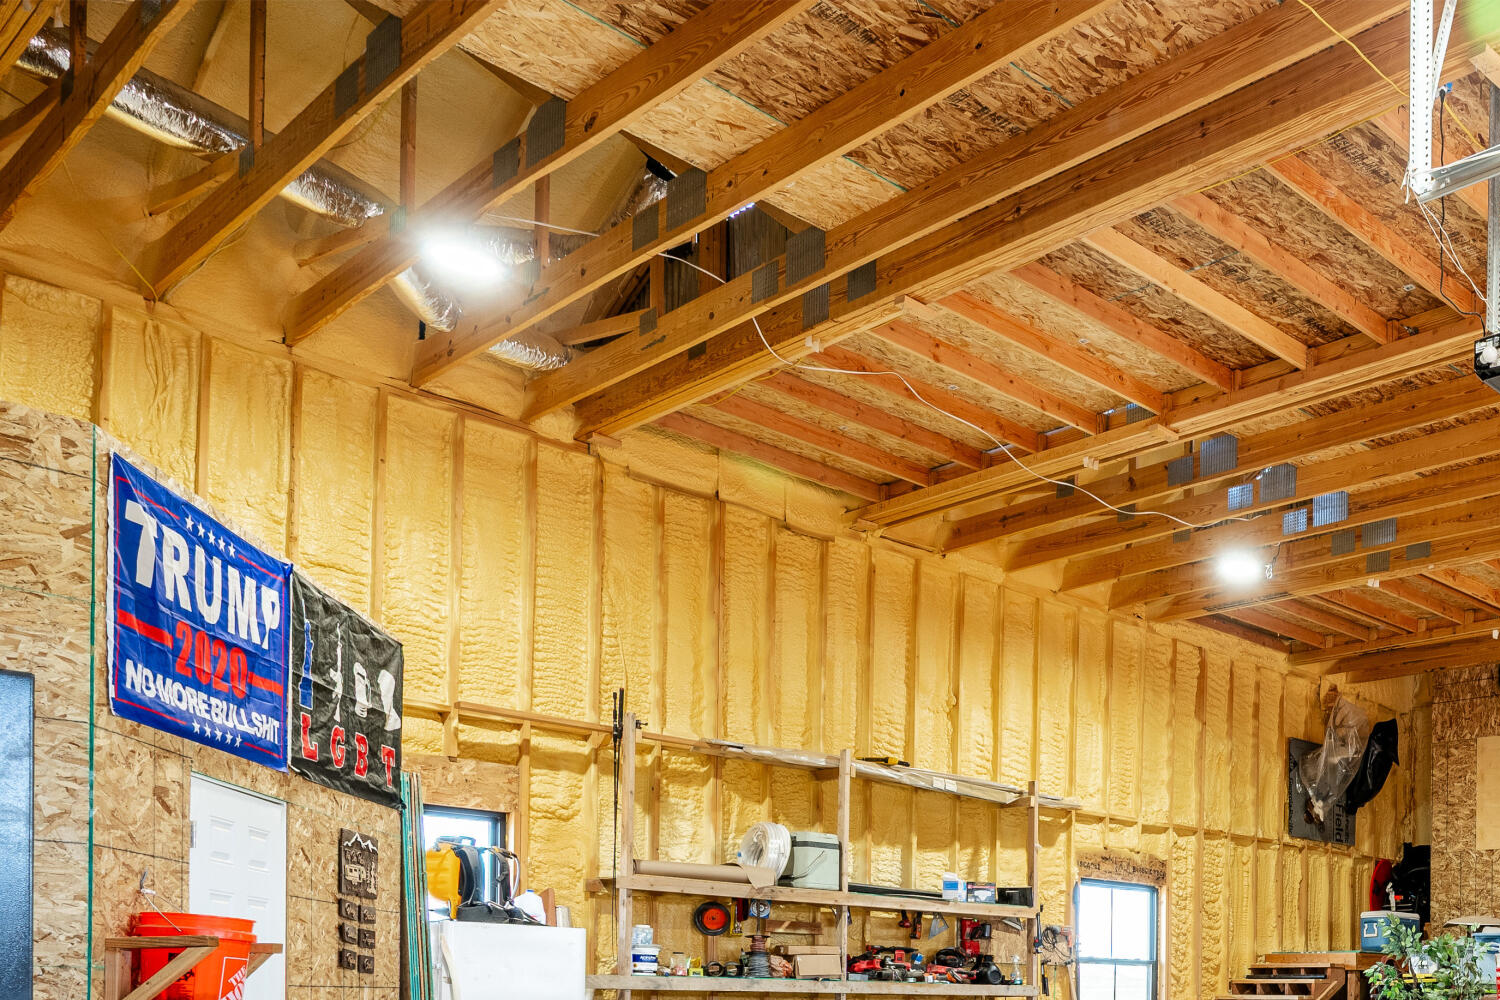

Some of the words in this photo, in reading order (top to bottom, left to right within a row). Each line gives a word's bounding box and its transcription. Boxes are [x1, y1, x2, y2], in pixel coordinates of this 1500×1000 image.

[124, 499, 281, 650] TRUMP
[175, 620, 248, 699] 2020
[125, 658, 157, 698] NO
[156, 673, 211, 720] MORE
[209, 695, 280, 744] BULLSHIT
[301, 714, 396, 788] LGBT
[227, 964, 248, 987] THE
